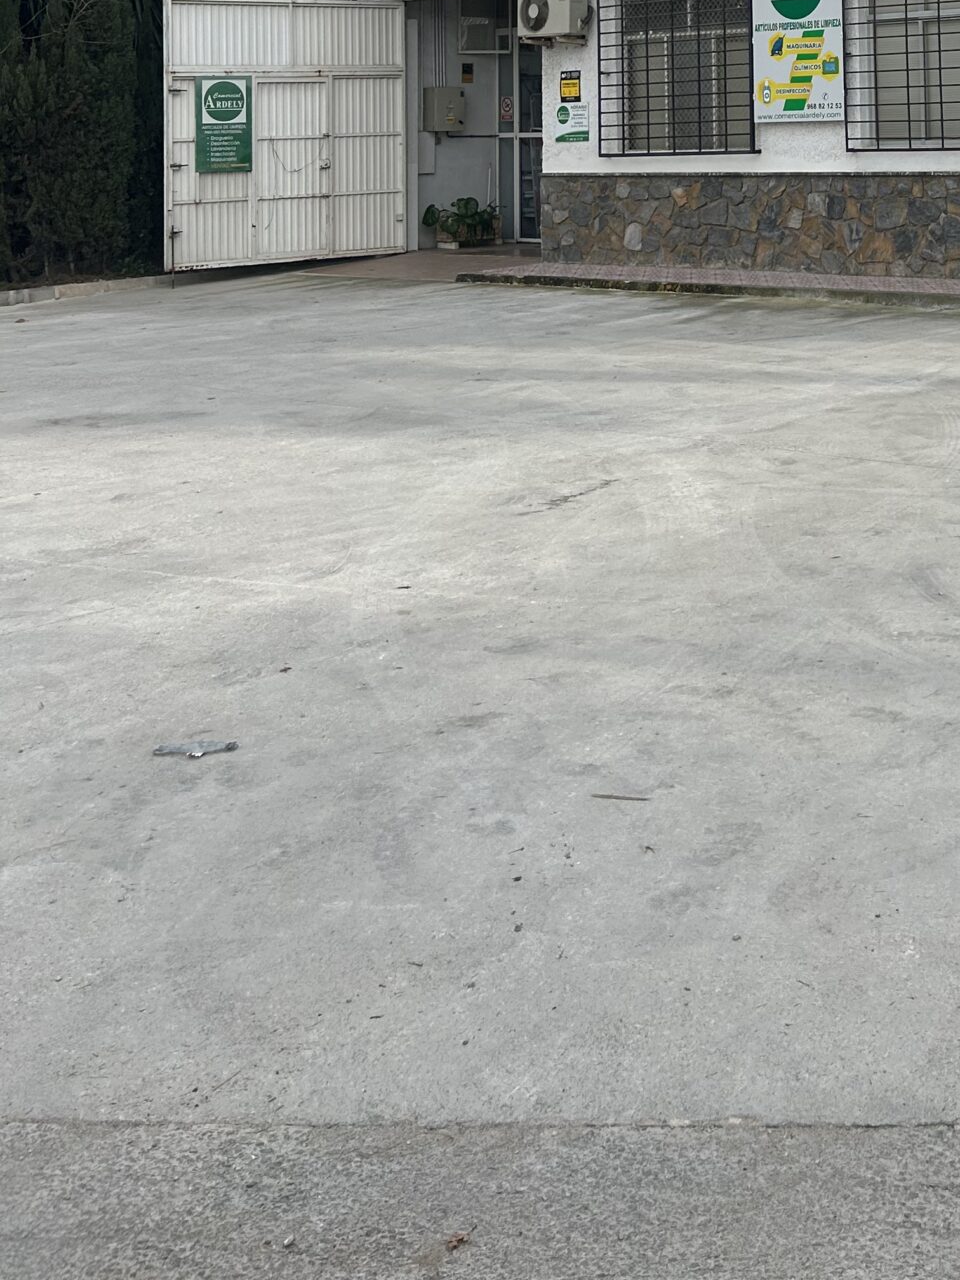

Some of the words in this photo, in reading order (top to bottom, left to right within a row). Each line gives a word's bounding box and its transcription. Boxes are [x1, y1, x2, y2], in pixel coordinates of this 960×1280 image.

[779, 20, 814, 31] PROFESIONALES
[814, 19, 820, 28] DE
[821, 18, 841, 28] LIMPIEZA
[205, 94, 243, 109] ARDELY
[757, 112, 842, 120] www.comercialardely.com
